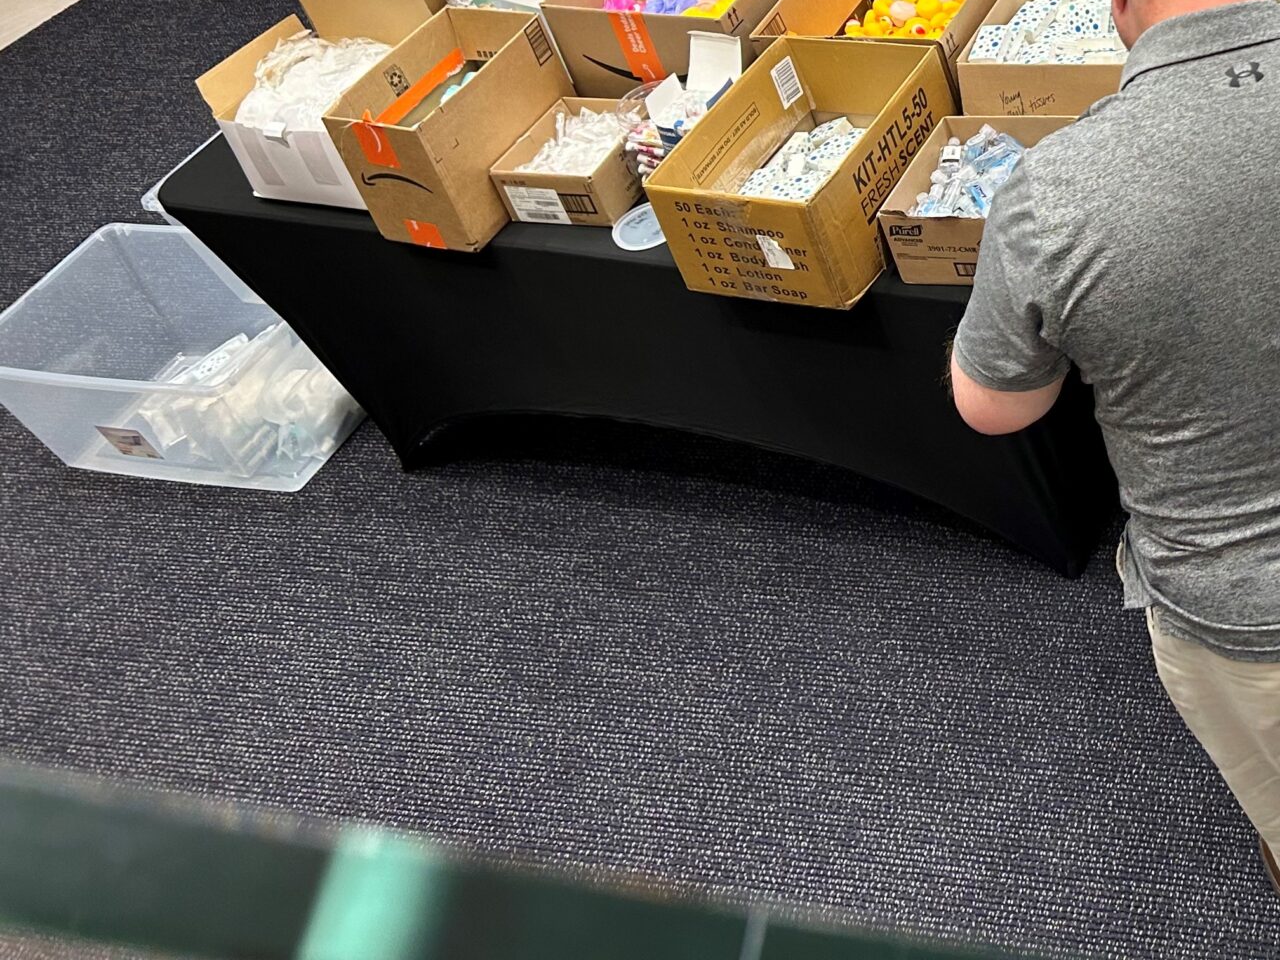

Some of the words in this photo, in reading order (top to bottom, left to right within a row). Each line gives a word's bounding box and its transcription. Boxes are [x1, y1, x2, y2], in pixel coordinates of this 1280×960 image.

[852, 87, 928, 194] KIT-HTL5-50
[860, 159, 900, 217] FRESH
[898, 111, 935, 167] SCENT
[675, 201, 691, 213] 50
[682, 218, 688, 228] 1
[694, 220, 710, 230] oz
[716, 221, 784, 240] Shampoo
[891, 225, 920, 237] Purell
[688, 233, 696, 243] 1
[701, 236, 717, 245] oz
[723, 237, 808, 258] Condner
[695, 248, 703, 258] 1
[707, 251, 724, 261] oz
[730, 252, 767, 269] Body
[702, 263, 709, 273] 1
[714, 266, 731, 275] oz
[737, 266, 783, 282] Lotion
[708, 277, 716, 287] 1
[720, 280, 737, 289] oz
[744, 280, 768, 294] Bar
[773, 285, 808, 300] Soap
